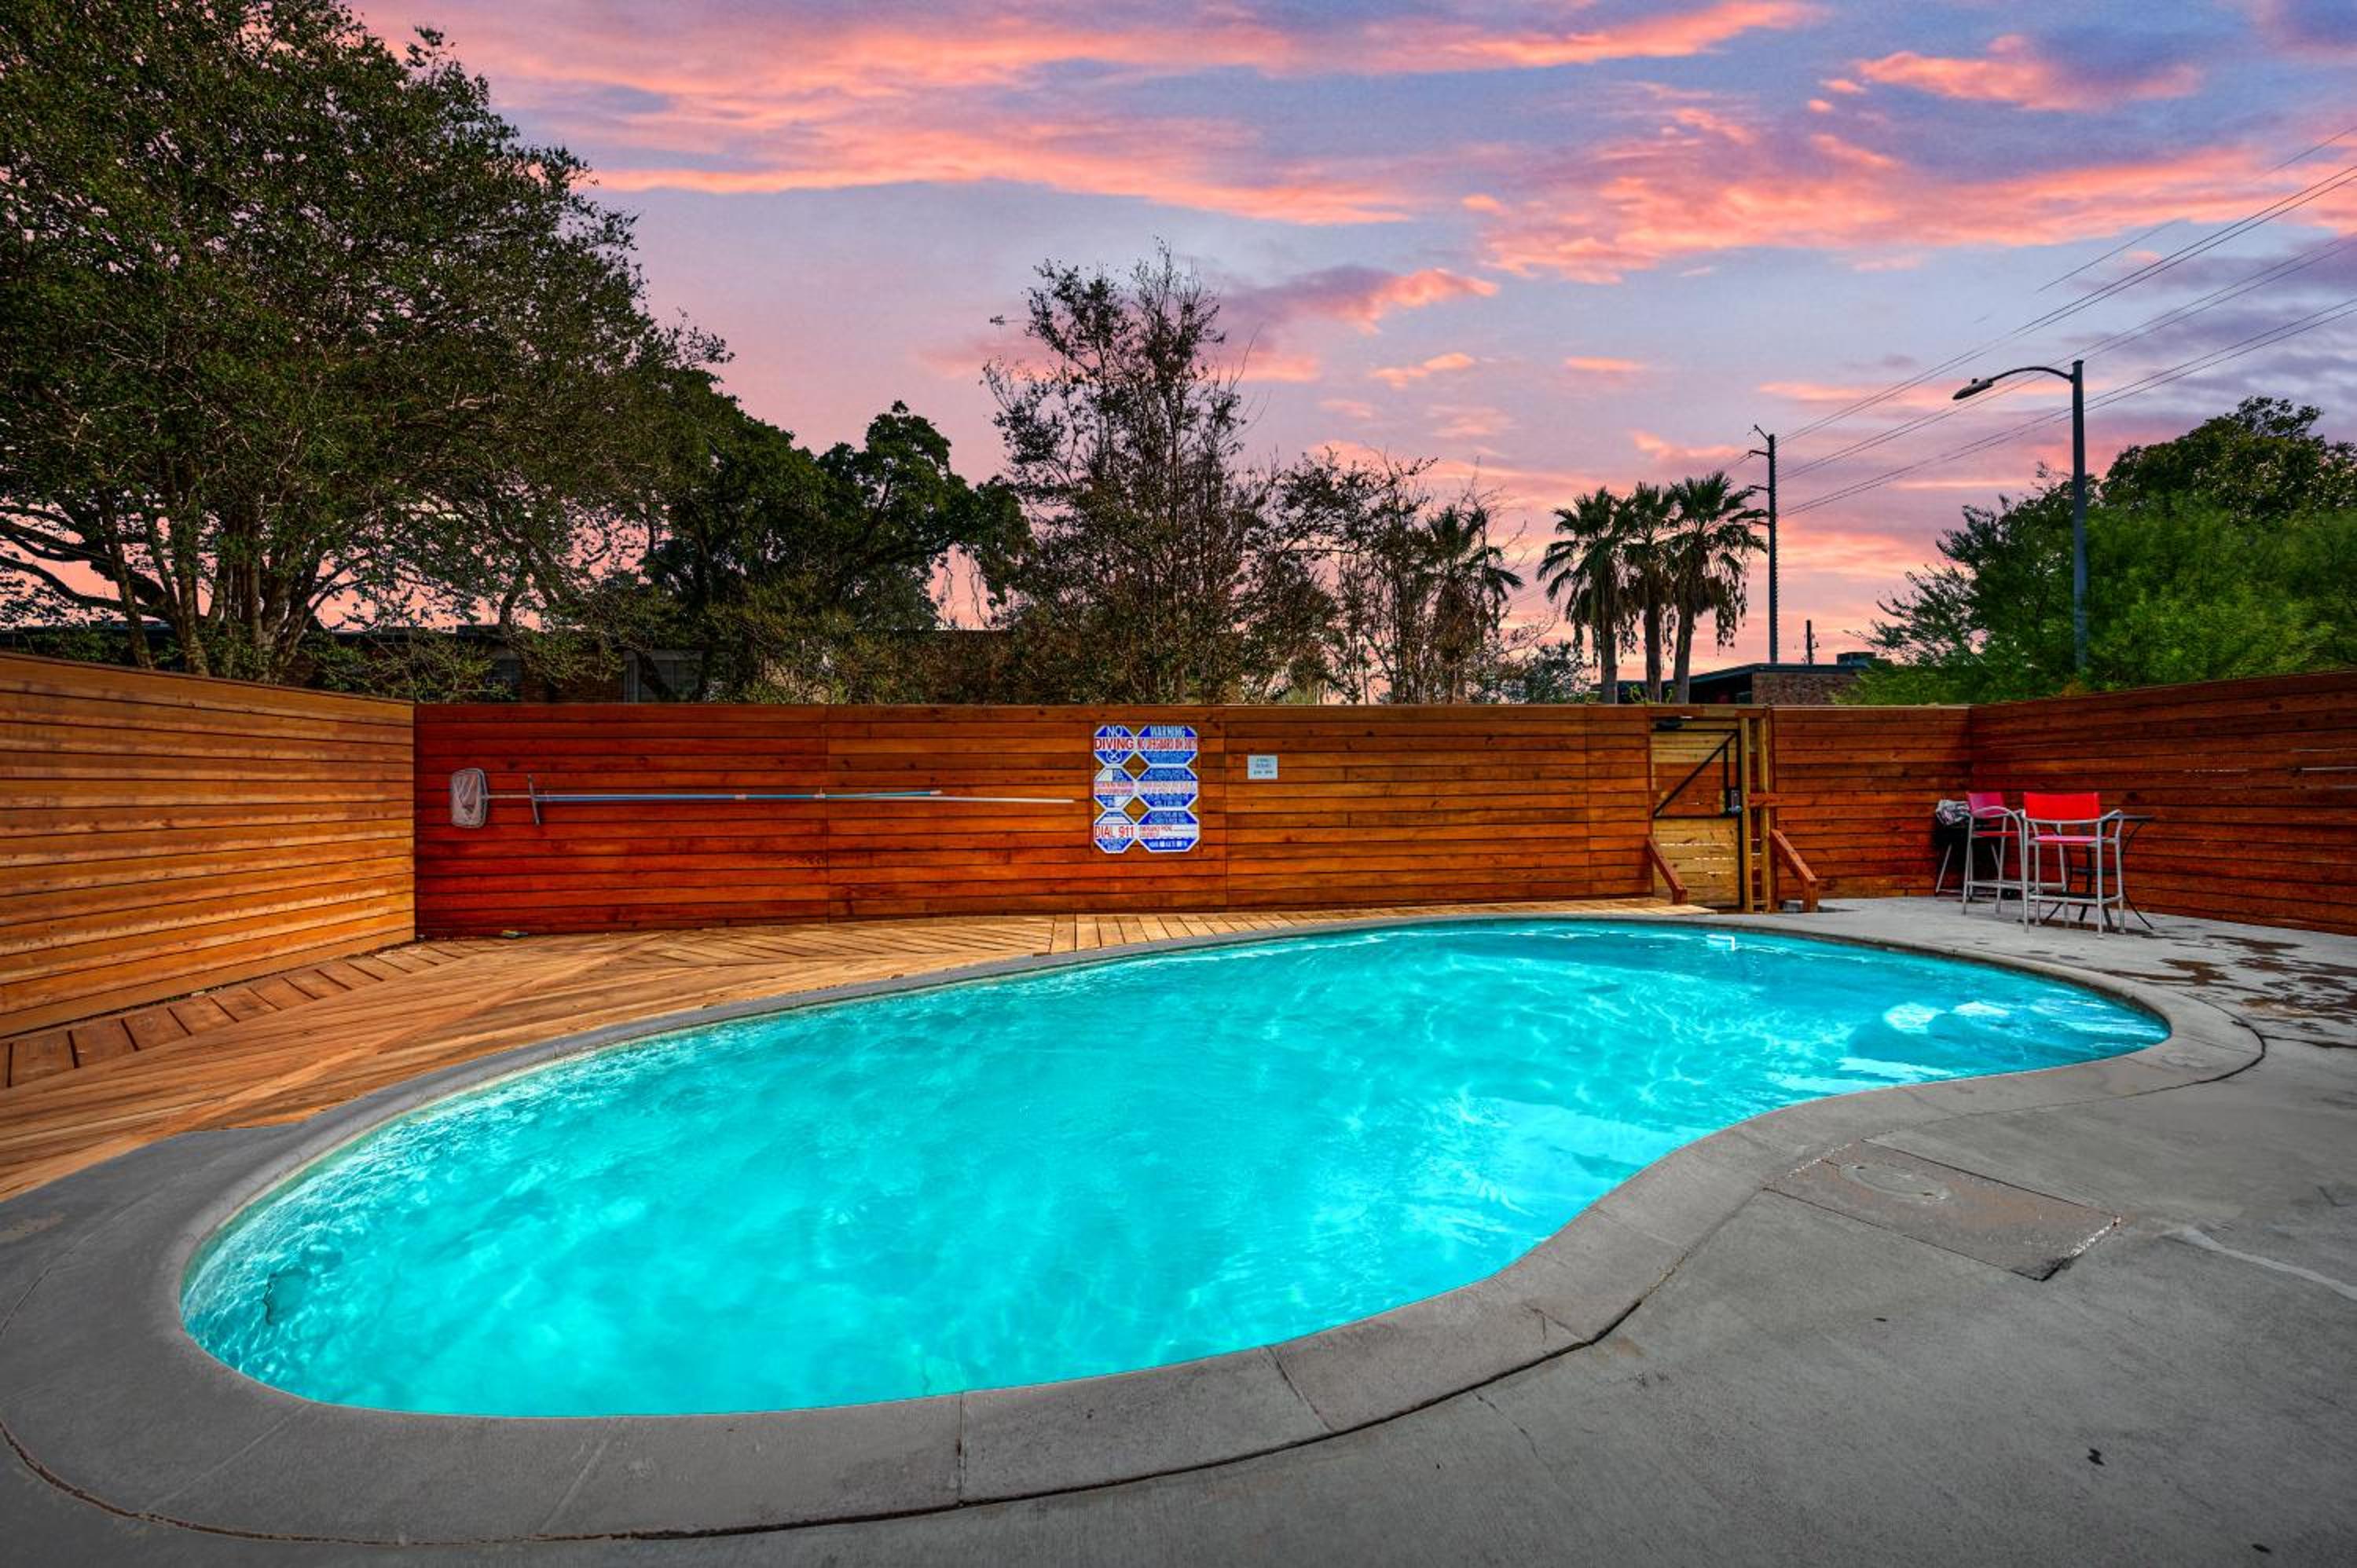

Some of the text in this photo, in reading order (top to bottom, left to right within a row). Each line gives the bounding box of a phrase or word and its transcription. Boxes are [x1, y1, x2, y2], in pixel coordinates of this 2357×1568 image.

[1106, 725, 1123, 737] NO
[1150, 726, 1185, 737] WARNING
[1094, 738, 1134, 749] DIVING
[1094, 826, 1113, 837] DIAL
[1119, 826, 1134, 837] 911
